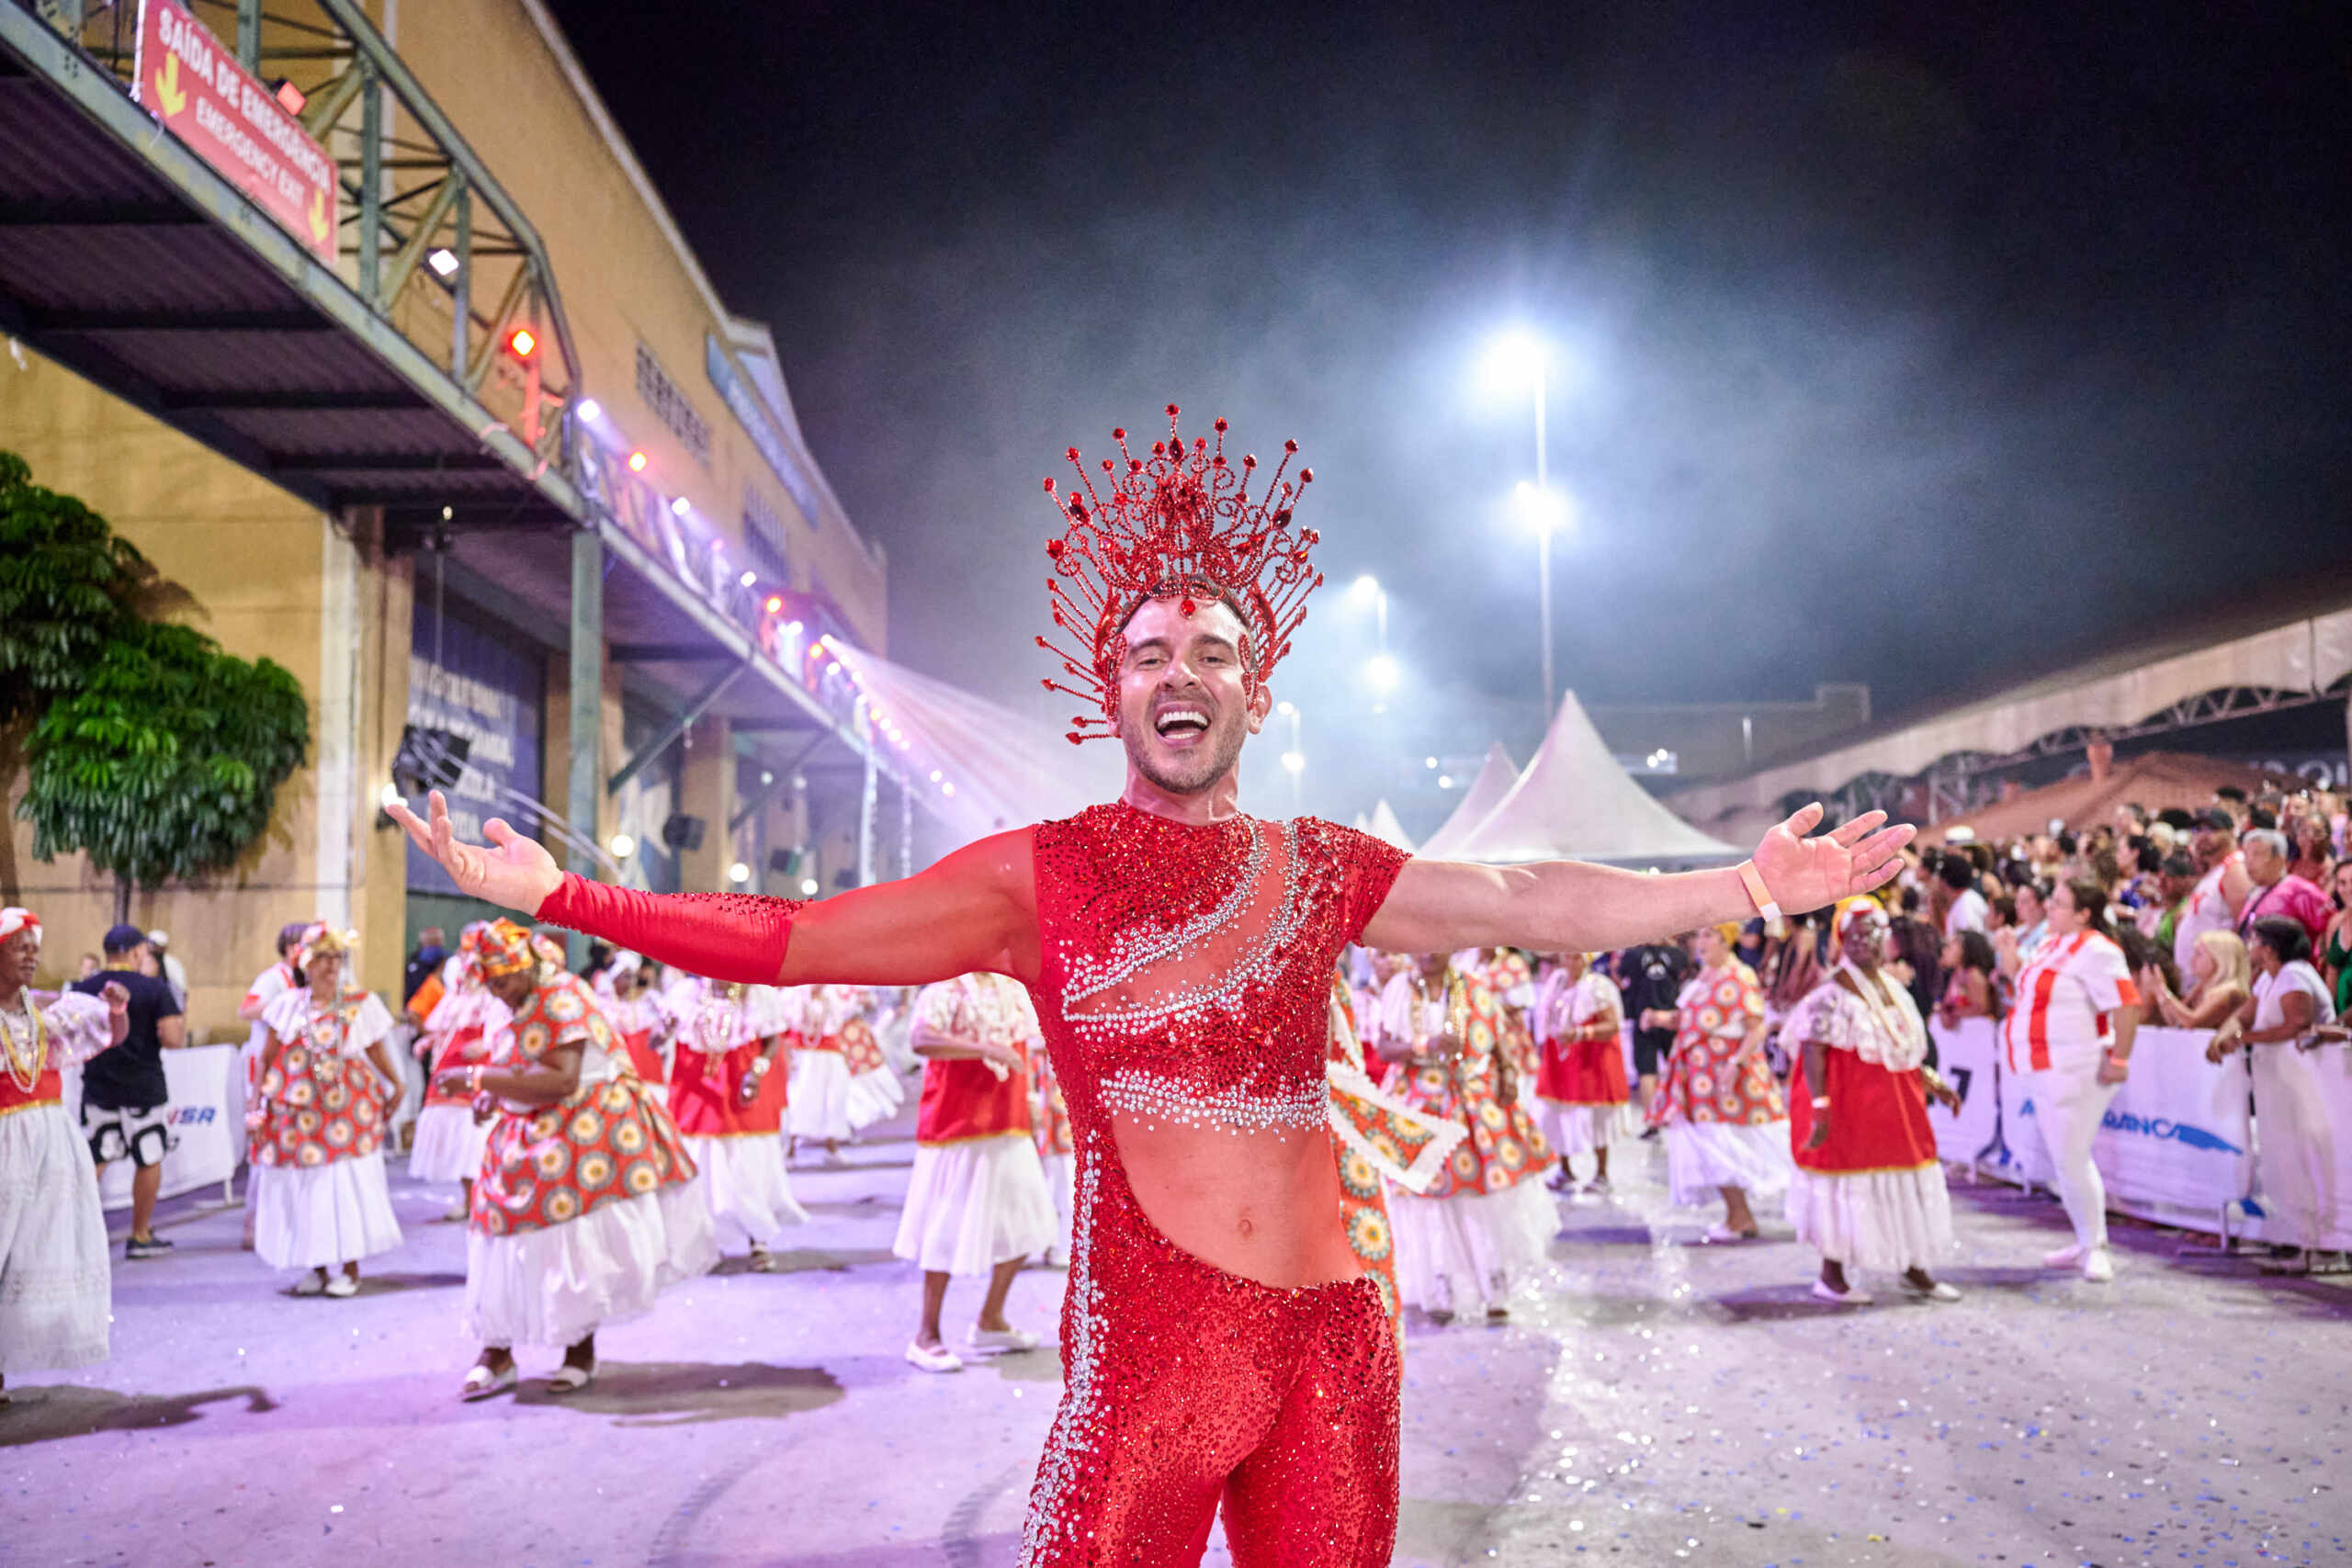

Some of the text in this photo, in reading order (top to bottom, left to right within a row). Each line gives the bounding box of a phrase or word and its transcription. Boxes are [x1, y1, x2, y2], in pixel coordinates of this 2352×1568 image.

[158, 7, 214, 85] SAÍDA
[216, 61, 240, 108] DE
[196, 96, 305, 209] EMERGENCY EXIT
